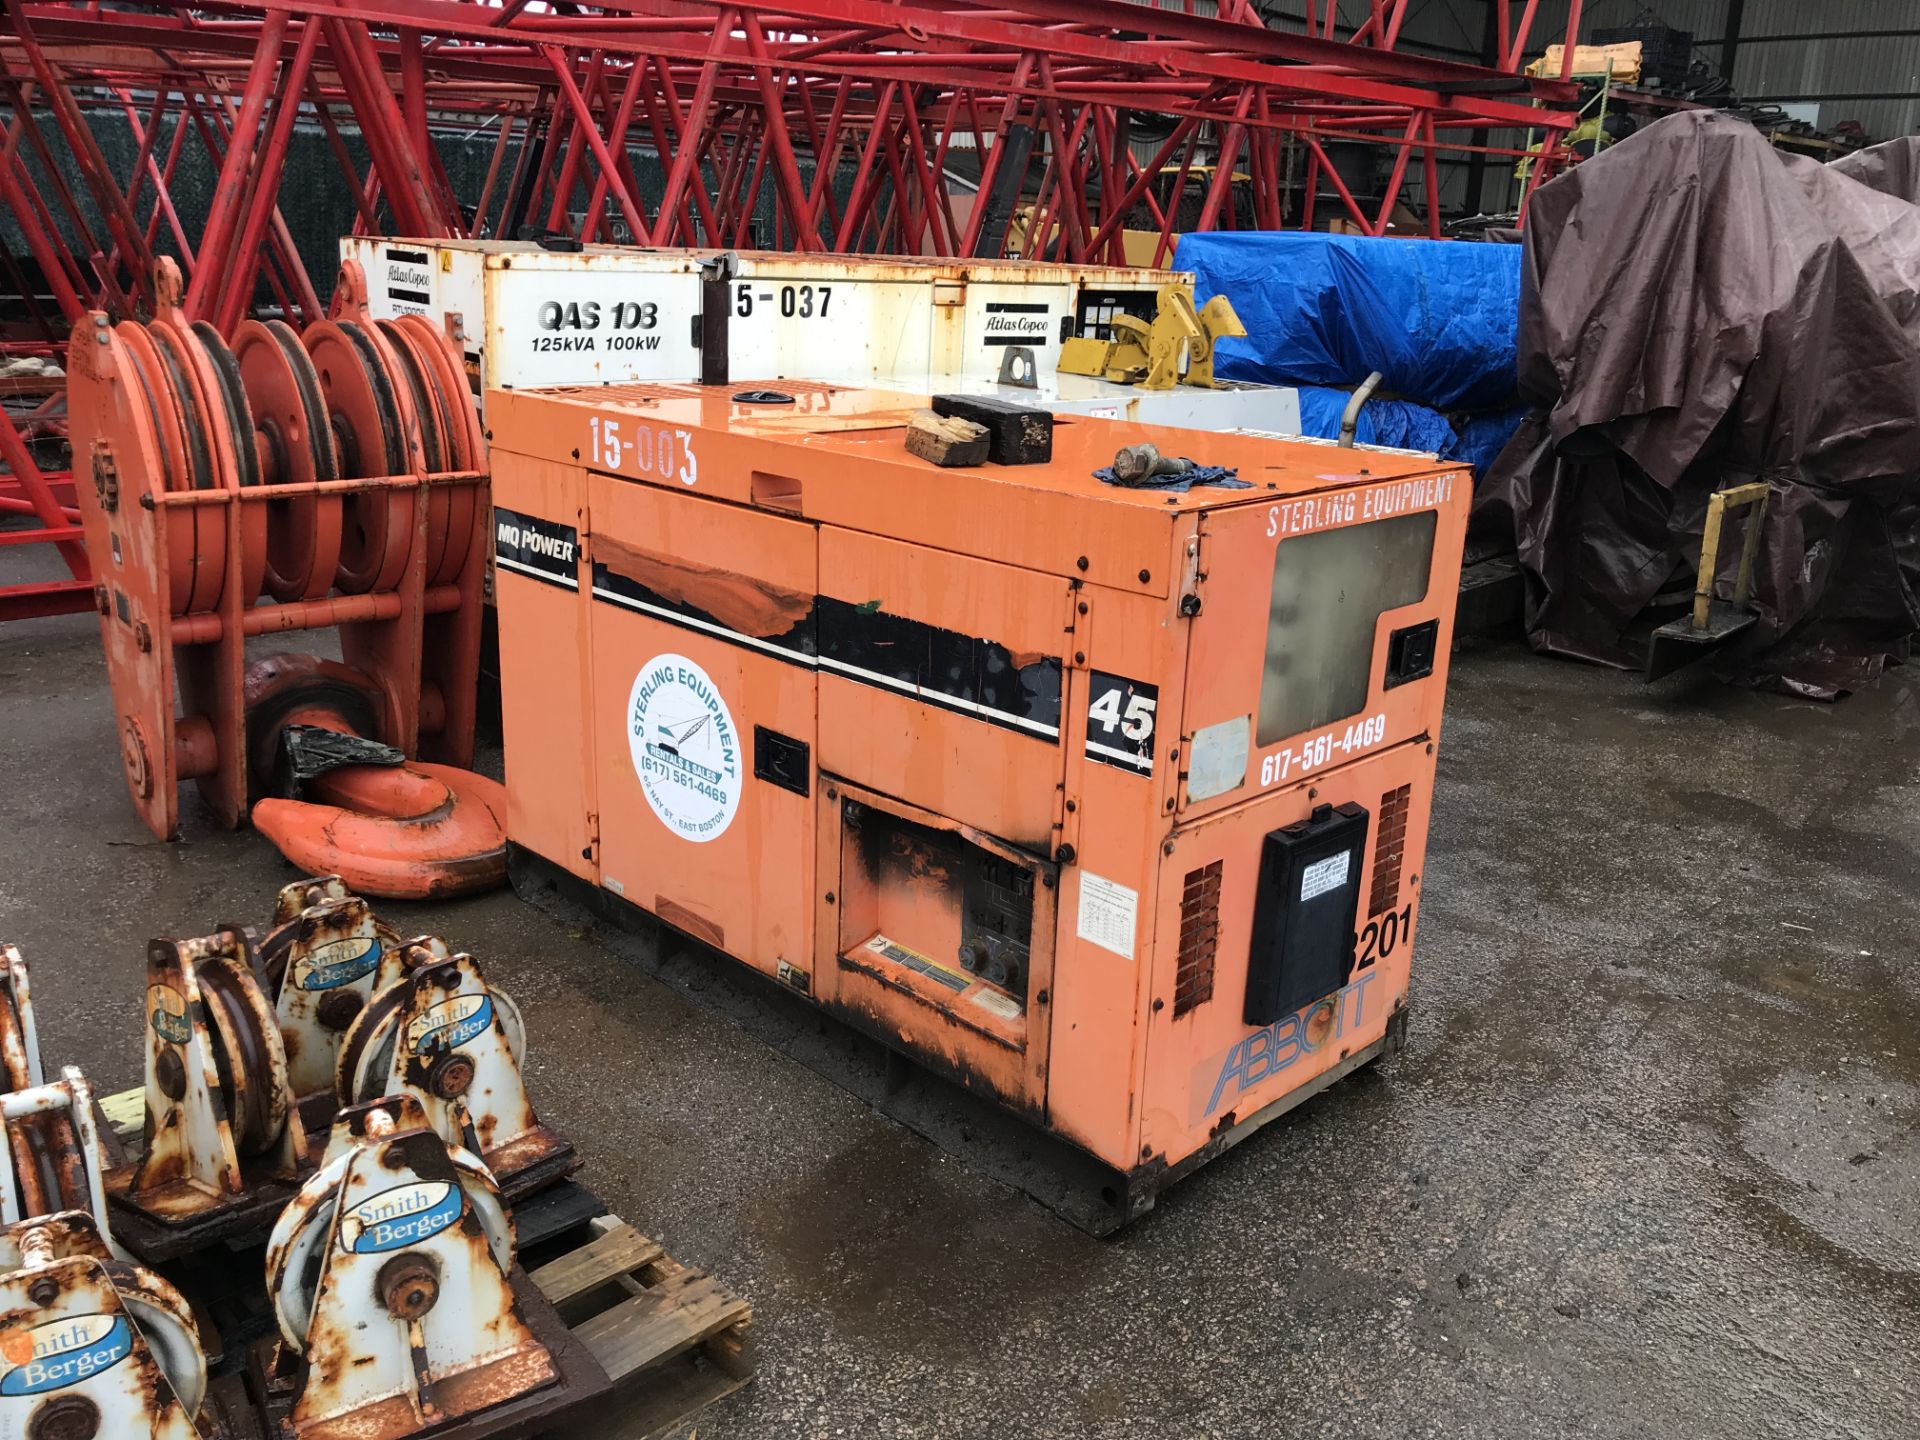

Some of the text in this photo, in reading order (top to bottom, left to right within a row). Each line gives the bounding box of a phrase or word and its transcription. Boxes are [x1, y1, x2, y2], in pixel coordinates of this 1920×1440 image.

[388, 265, 430, 288] Atlas Copco
[538, 301, 658, 332] QAS 108
[985, 316, 1048, 333] Atlas Copco
[531, 336, 661, 352] 125kVA 100kW
[590, 416, 697, 486] 15-003
[1266, 474, 1456, 538] STERLING EQUIPMENT
[498, 523, 573, 563] MQ POWER
[634, 666, 735, 779] STERLING EQUIPMENT
[1088, 688, 1157, 741] 45
[1260, 713, 1386, 787] 617-561-4469
[642, 756, 727, 805] (617) 561-4469
[691, 763, 717, 783] SALES
[650, 790, 664, 808] NAY
[679, 819, 696, 832] EAST
[699, 809, 725, 832] BOSTON
[420, 1003, 469, 1029] Smith
[1204, 971, 1377, 1118] ABBOTT
[358, 1191, 429, 1223] Smith
[374, 1210, 454, 1247] Berger
[24, 1345, 122, 1388] Berger
